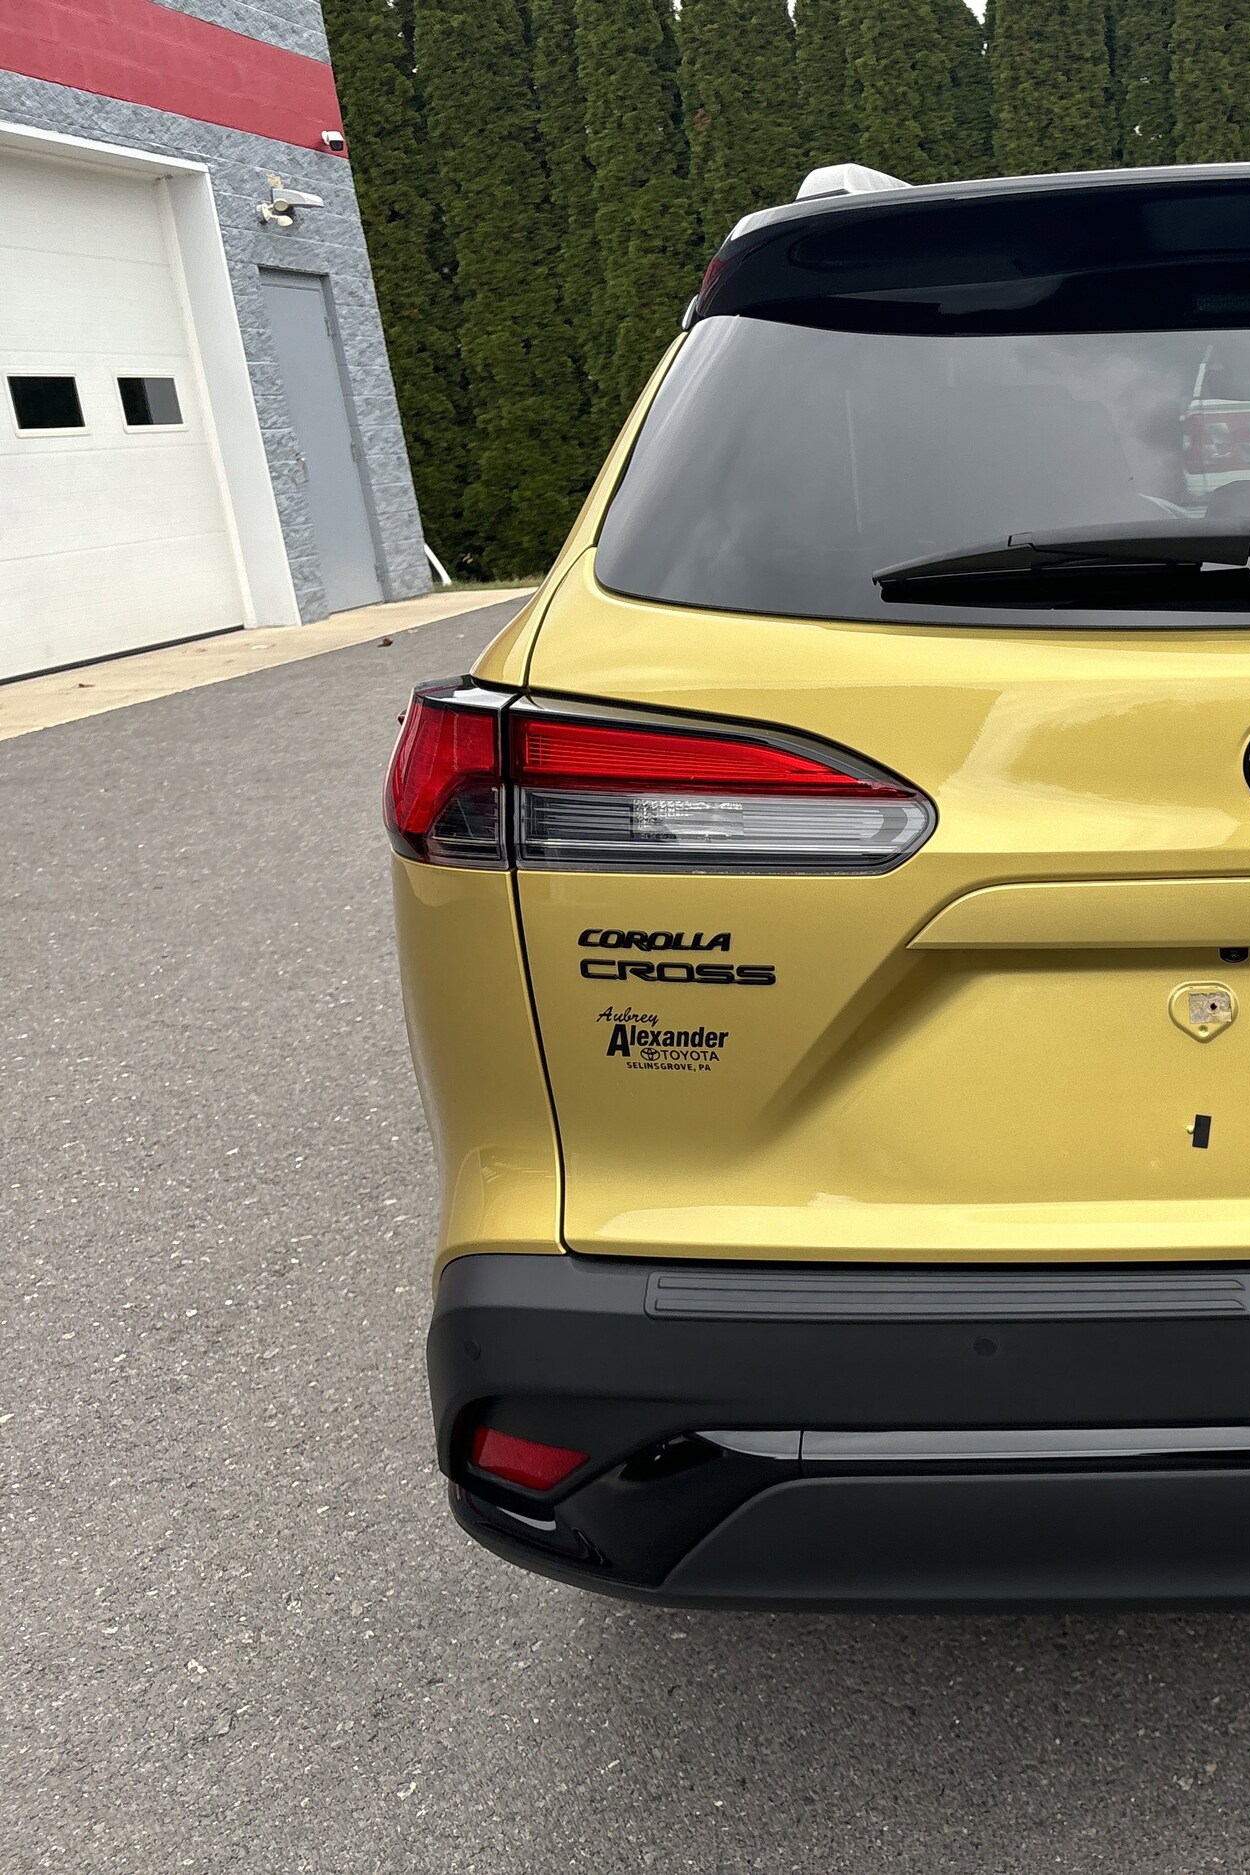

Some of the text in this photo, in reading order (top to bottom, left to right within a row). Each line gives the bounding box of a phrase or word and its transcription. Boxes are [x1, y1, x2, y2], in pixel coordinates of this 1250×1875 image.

[577, 928, 732, 951] COROLLA
[579, 958, 776, 986] CROSS
[596, 1005, 659, 1027] Aubrey
[606, 1023, 729, 1057] Alexander
[626, 1061, 711, 1072] SELINSGROVE, PA
[663, 1050, 720, 1062] TOYOTA
